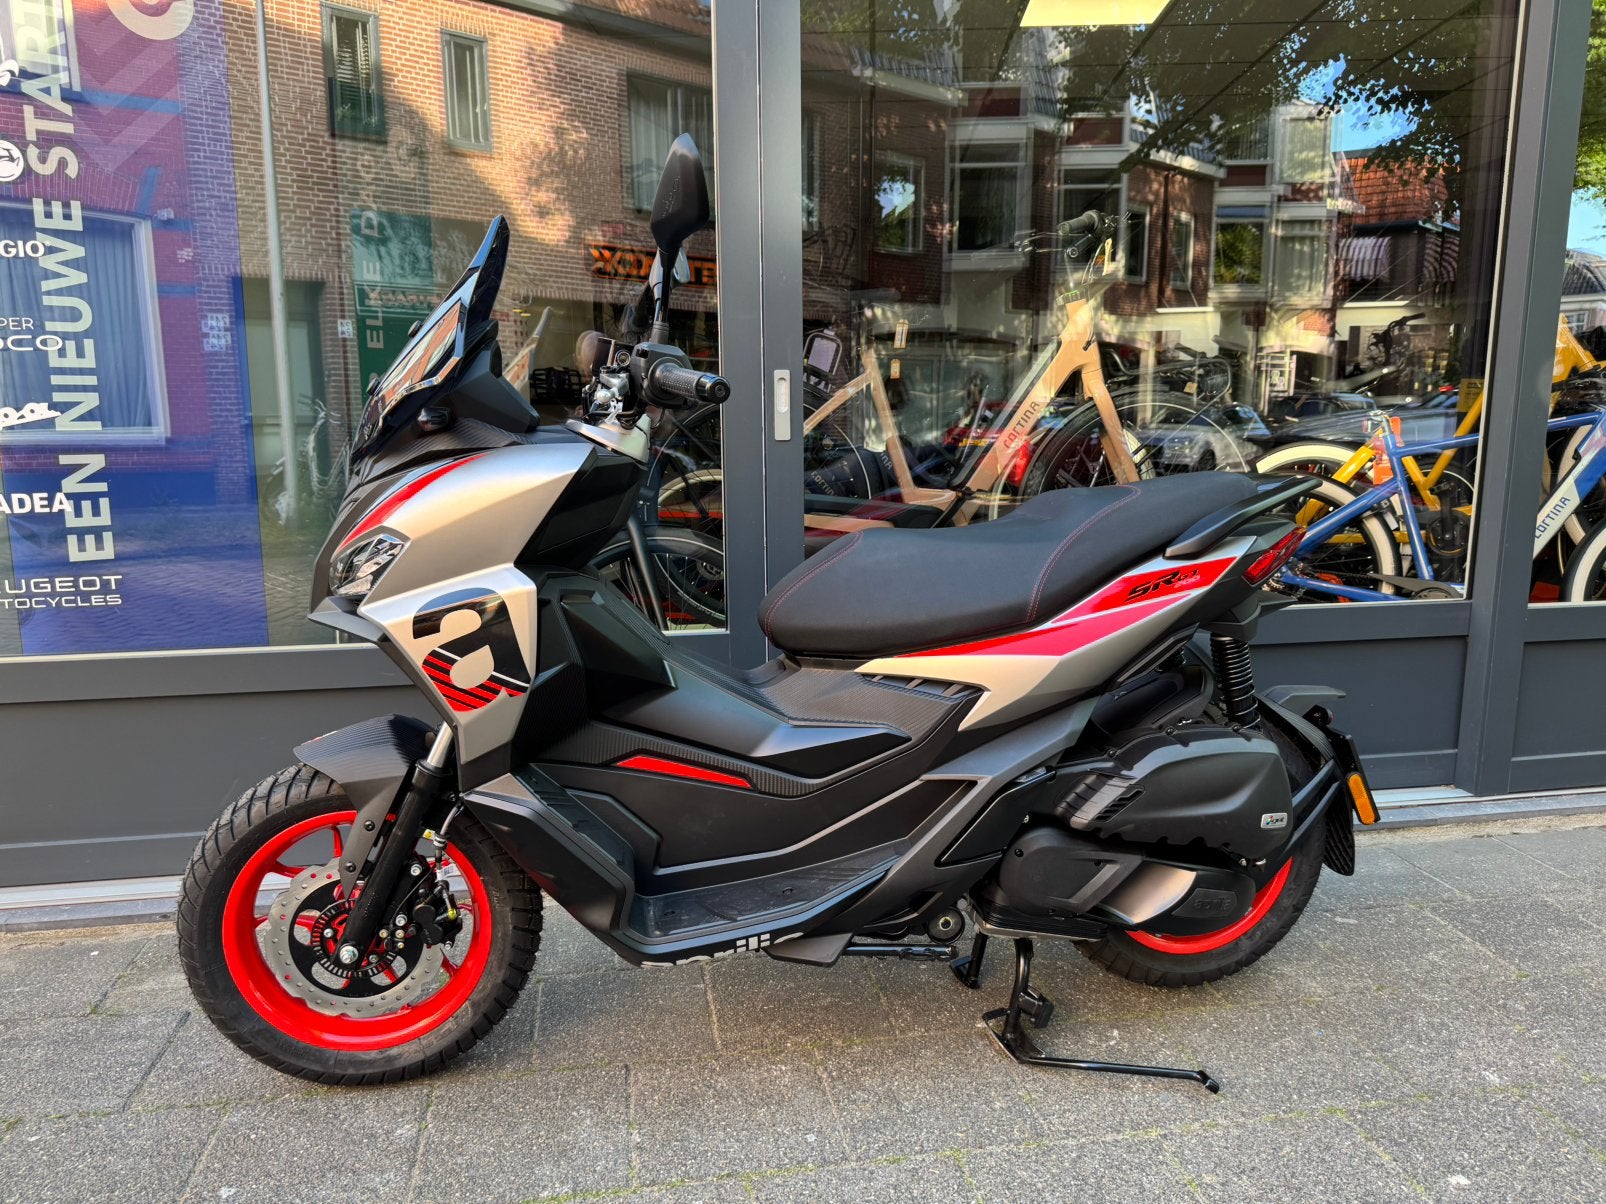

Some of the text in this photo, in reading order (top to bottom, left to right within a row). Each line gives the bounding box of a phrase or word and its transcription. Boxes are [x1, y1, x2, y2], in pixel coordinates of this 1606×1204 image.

[33, 198, 102, 431] NIEUWE
[361, 259, 384, 348] ELKE
[58, 454, 115, 562] EEN
